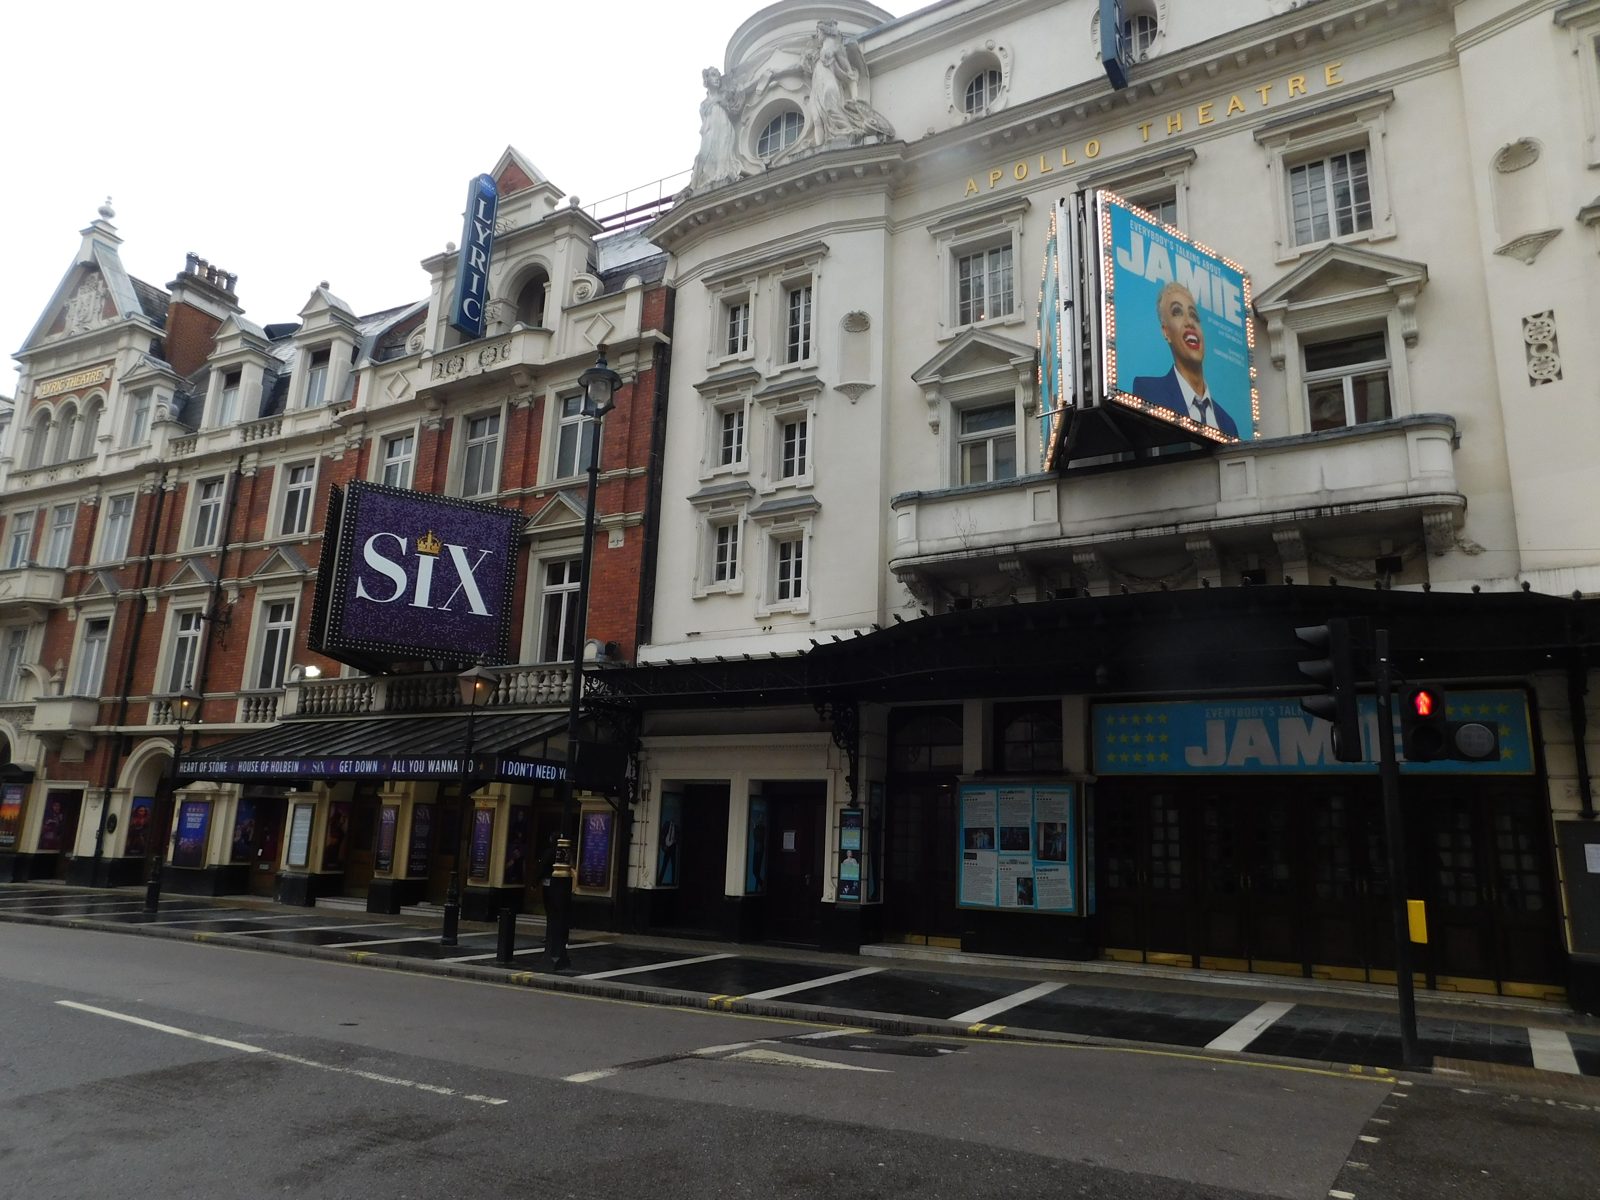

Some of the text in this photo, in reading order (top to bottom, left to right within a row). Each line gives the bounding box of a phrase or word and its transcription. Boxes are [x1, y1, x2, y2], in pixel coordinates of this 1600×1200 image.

[964, 62, 1344, 197] APOLLO THEATRE
[463, 198, 493, 322] LYRIC
[1129, 219, 1222, 277] EVERYBODY'S TALKING ABOUT
[1116, 230, 1243, 327] JAMIE
[42, 369, 104, 395] LYRIC THEATRE
[1205, 706, 1275, 718] EVERYBODY'S
[179, 761, 198, 773] HEART
[199, 761, 207, 773] OF
[208, 761, 228, 773] STONE
[237, 760, 259, 772] HOUSE
[260, 760, 269, 772] OF
[270, 760, 299, 773] HOLBEIN
[339, 760, 353, 773] GET
[355, 760, 378, 773] DOWN
[392, 760, 406, 773] ALL
[408, 760, 425, 773] YOU
[428, 760, 458, 773] WANNA
[502, 761, 506, 774] I
[508, 761, 534, 777] DON'T
[535, 765, 556, 780] NEED
